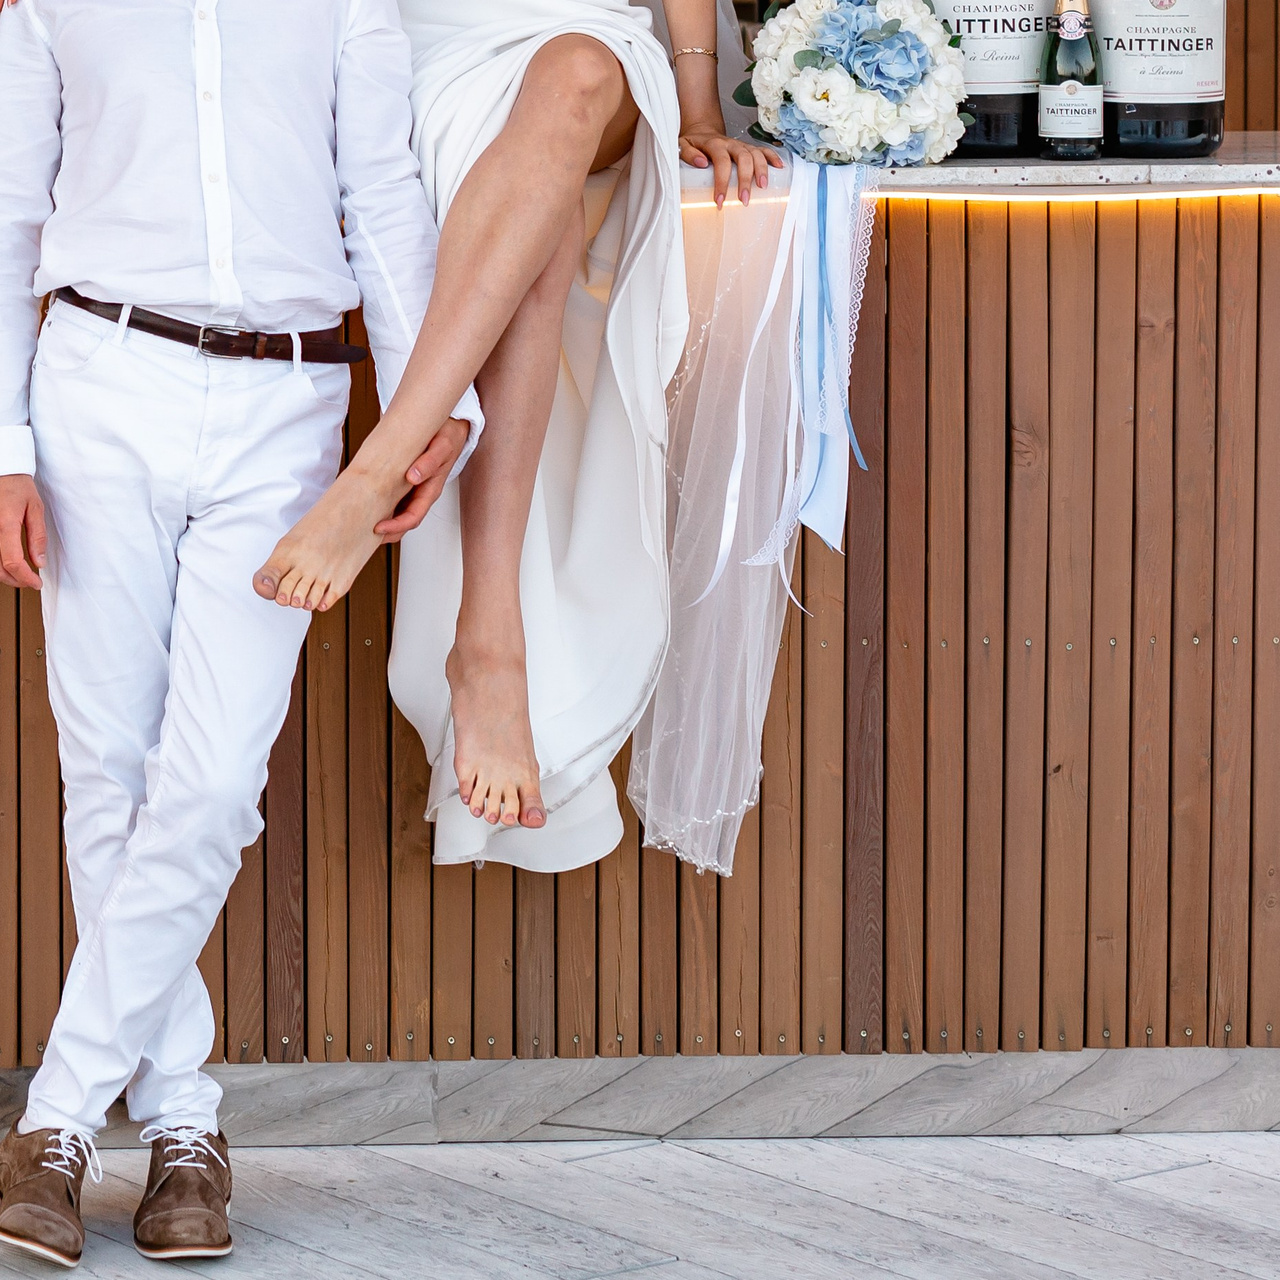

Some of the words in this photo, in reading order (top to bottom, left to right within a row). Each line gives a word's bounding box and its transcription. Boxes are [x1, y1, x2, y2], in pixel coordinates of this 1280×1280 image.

[952, 3, 1035, 13] CHAMPAGNE
[941, 16, 1053, 34] ITTINGE
[1126, 26, 1198, 34] CHAMPAGNE
[1103, 37, 1214, 52] TAITTINGER
[979, 49, 1021, 62] Reims
[1046, 107, 1098, 116] TAITTINGER
